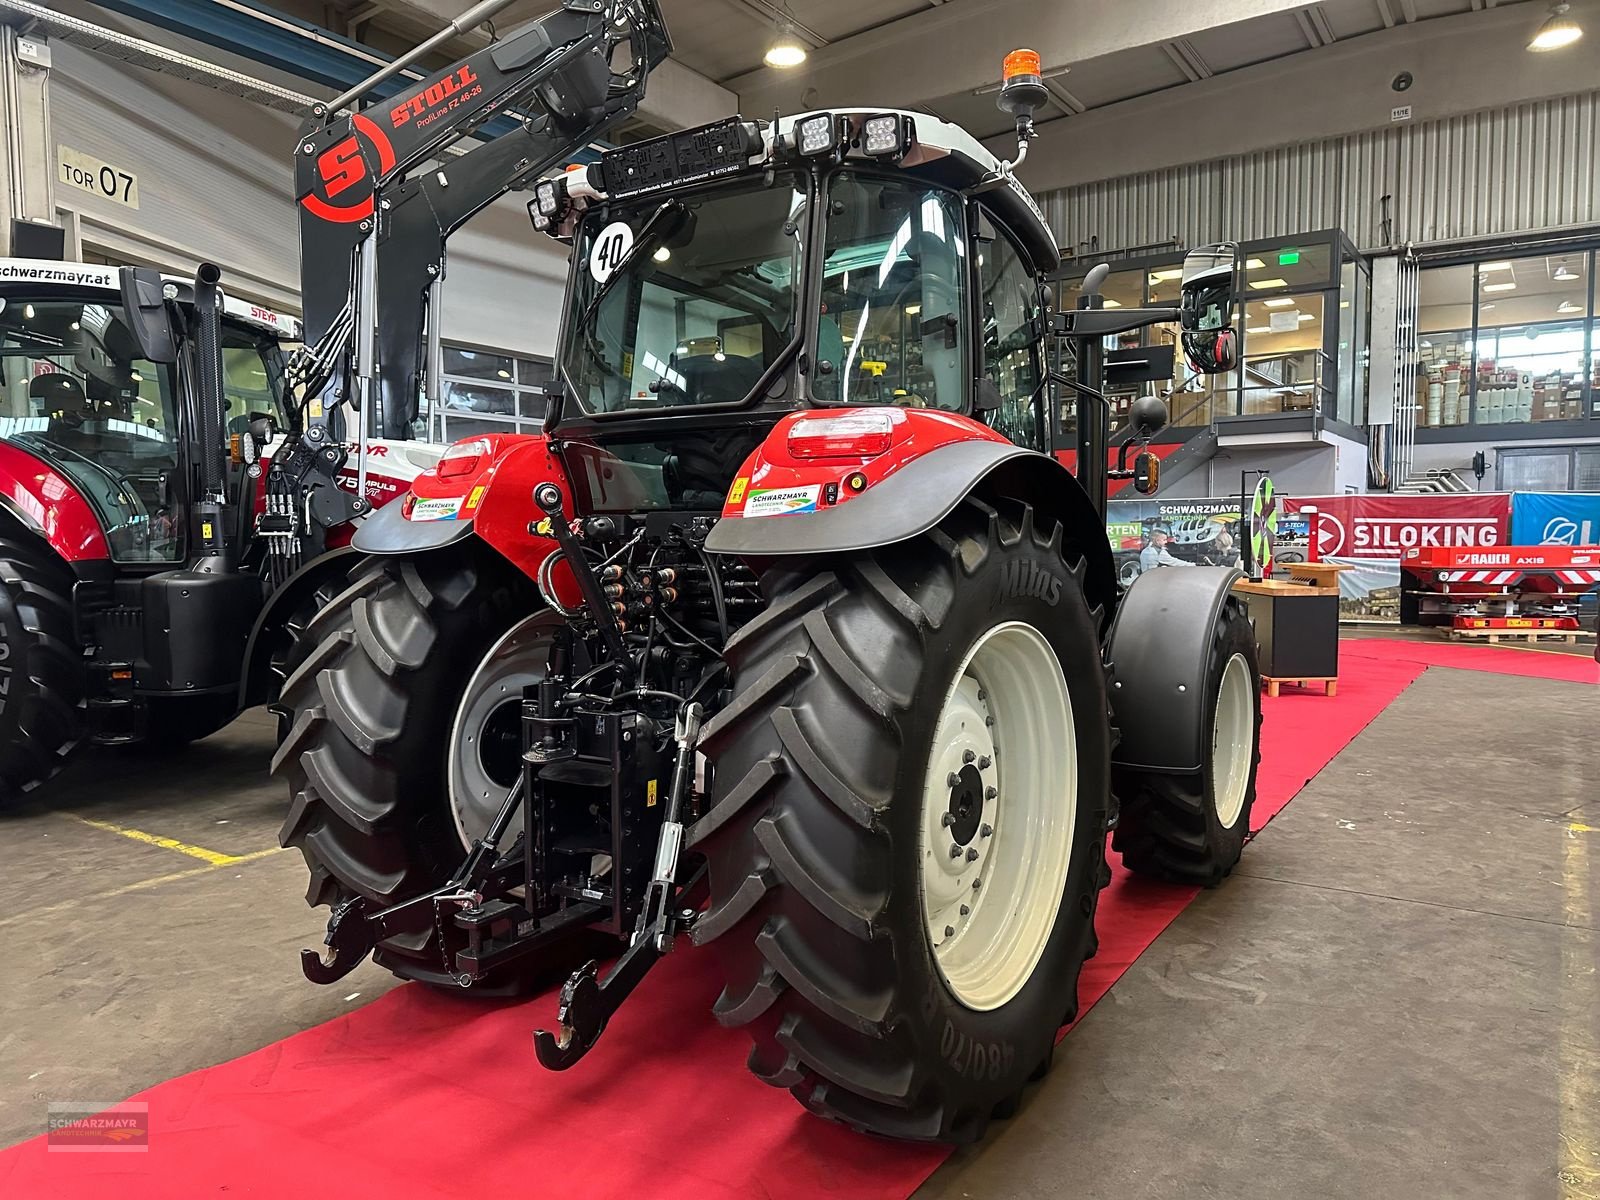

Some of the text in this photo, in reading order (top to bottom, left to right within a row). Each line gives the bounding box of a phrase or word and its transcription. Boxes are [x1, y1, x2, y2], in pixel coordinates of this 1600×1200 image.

[390, 64, 478, 129] STOLL
[416, 106, 448, 129] ProfiLine
[448, 98, 460, 111] FZ
[460, 84, 482, 103] 46-26
[62, 163, 133, 202] TOR 07
[597, 233, 624, 271] 40
[250, 306, 278, 325] STEYR
[365, 480, 397, 492] MPULS
[752, 491, 808, 503] SCHWARZMAYR
[1160, 504, 1240, 515] SCHWARZMAYR
[1106, 525, 1138, 535] RTEN
[1353, 525, 1498, 547] SILOKING
[1470, 553, 1510, 565] RAUCH
